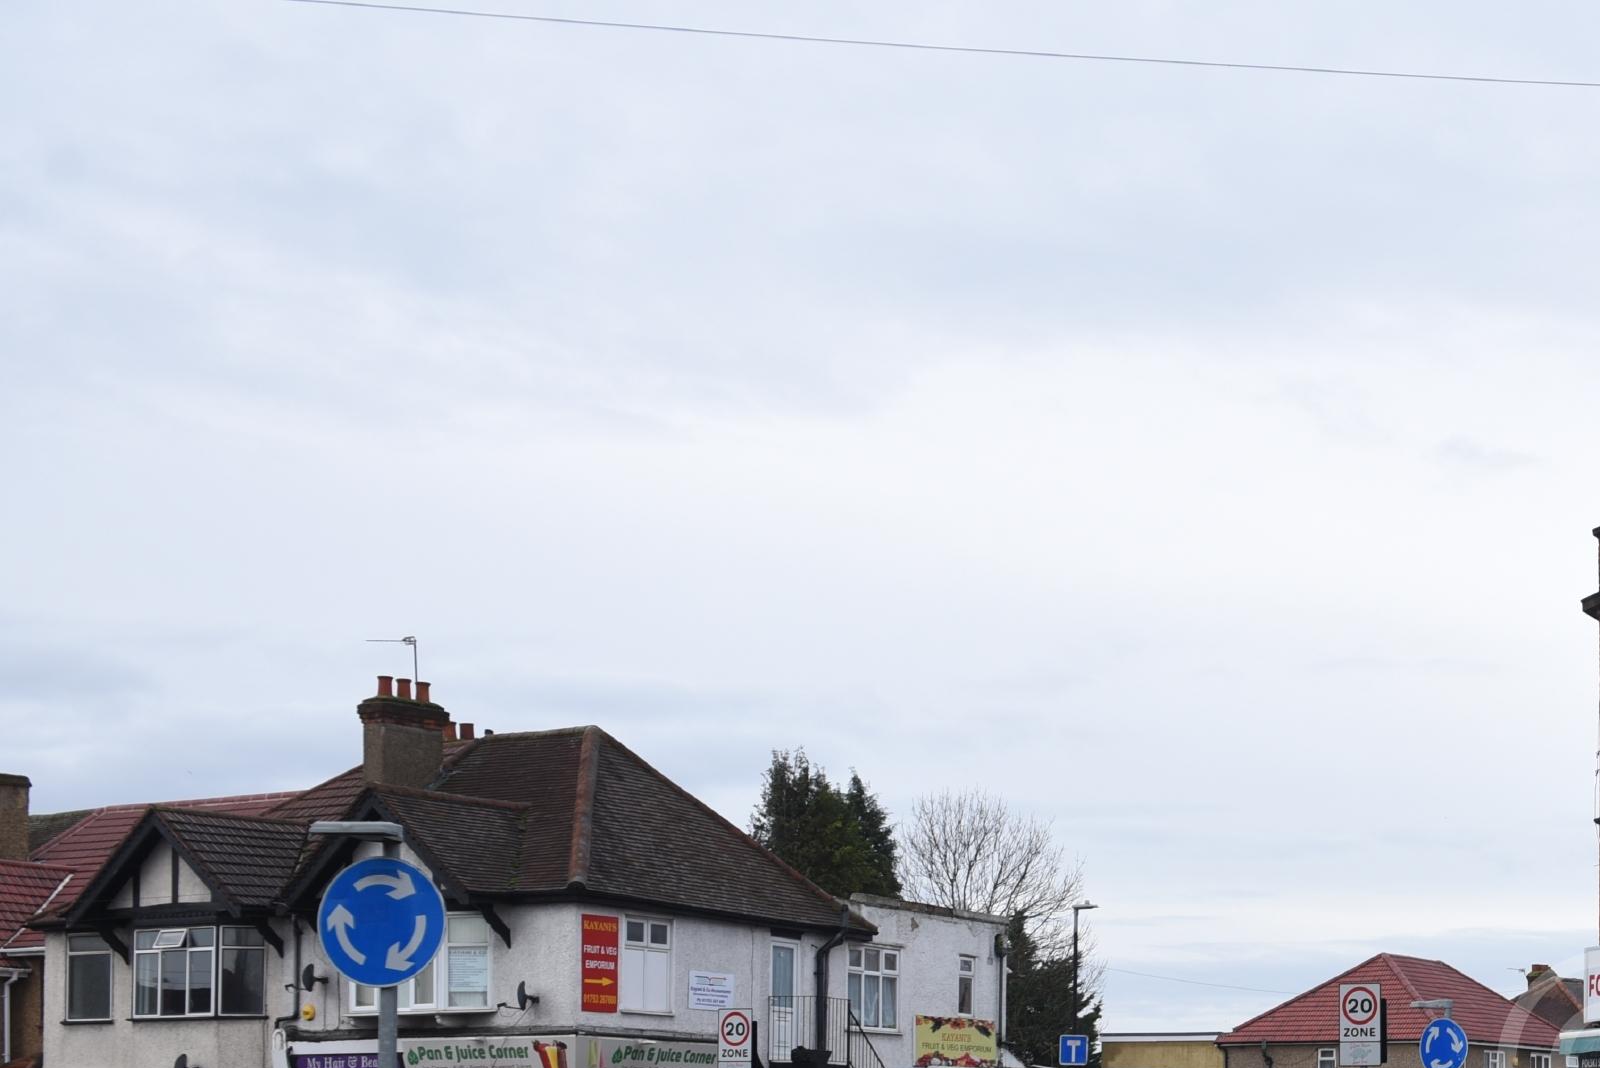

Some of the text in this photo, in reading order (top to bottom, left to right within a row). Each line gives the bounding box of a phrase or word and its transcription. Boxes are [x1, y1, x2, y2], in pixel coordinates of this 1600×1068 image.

[605, 946, 617, 956] VEG
[585, 959, 615, 970] EMPORIUM
[1348, 998, 1373, 1014] 20
[725, 1022, 746, 1037] 20
[1343, 1027, 1376, 1038] ZONE
[417, 1046, 442, 1060] Pan
[456, 1045, 486, 1063] Juice
[489, 1044, 529, 1060] Corner
[623, 1045, 645, 1061] Pan
[655, 1048, 681, 1065] Juice
[683, 1050, 717, 1065] Corner
[721, 1049, 749, 1058] ZONE
[347, 1056, 358, 1068] &
[361, 1055, 378, 1068] Bea
